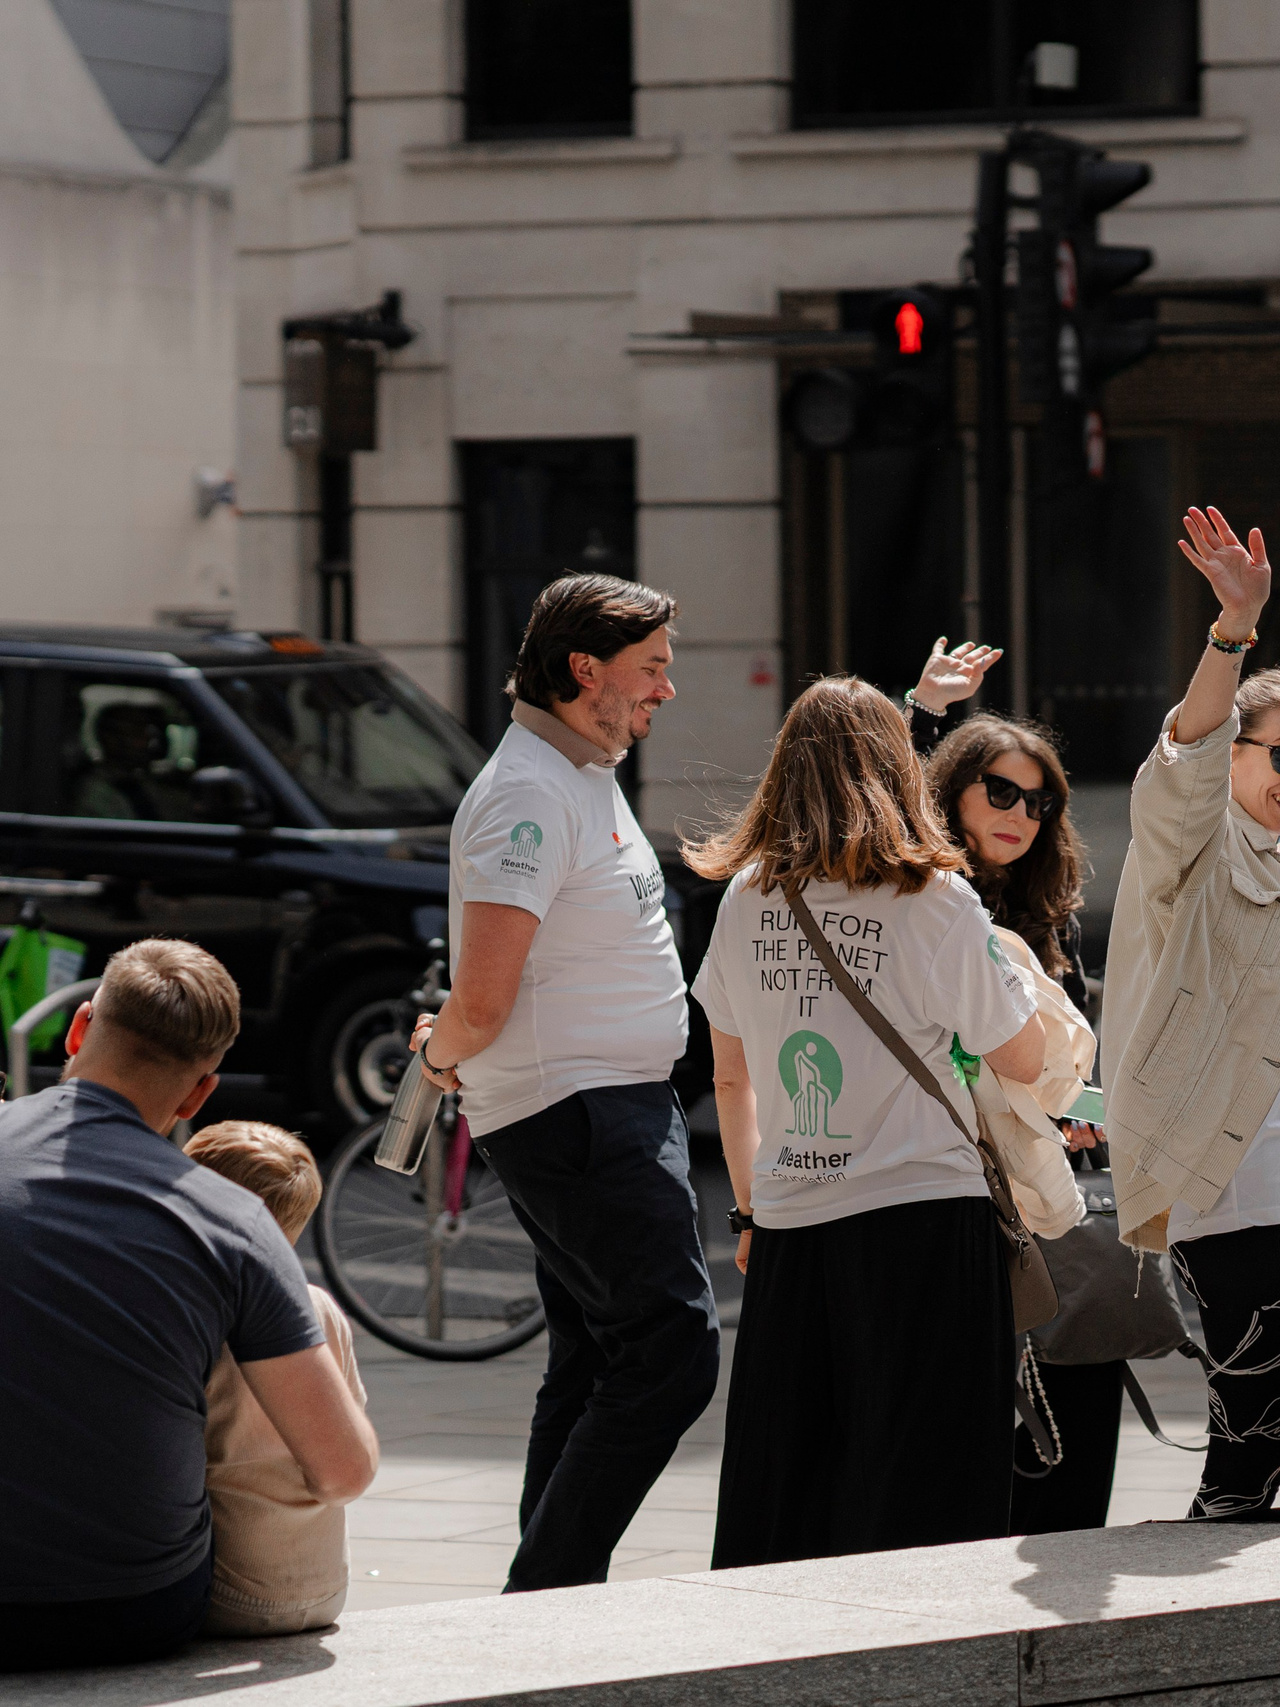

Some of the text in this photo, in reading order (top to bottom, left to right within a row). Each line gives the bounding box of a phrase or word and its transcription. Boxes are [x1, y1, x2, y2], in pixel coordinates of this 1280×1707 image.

[499, 866, 537, 880] Foundation
[501, 858, 539, 874] Weather
[822, 911, 883, 942] FOR
[752, 939, 787, 961] THE
[761, 969, 872, 996] NOT FRM
[800, 996, 819, 1017] IT
[777, 1146, 852, 1169] Weather
